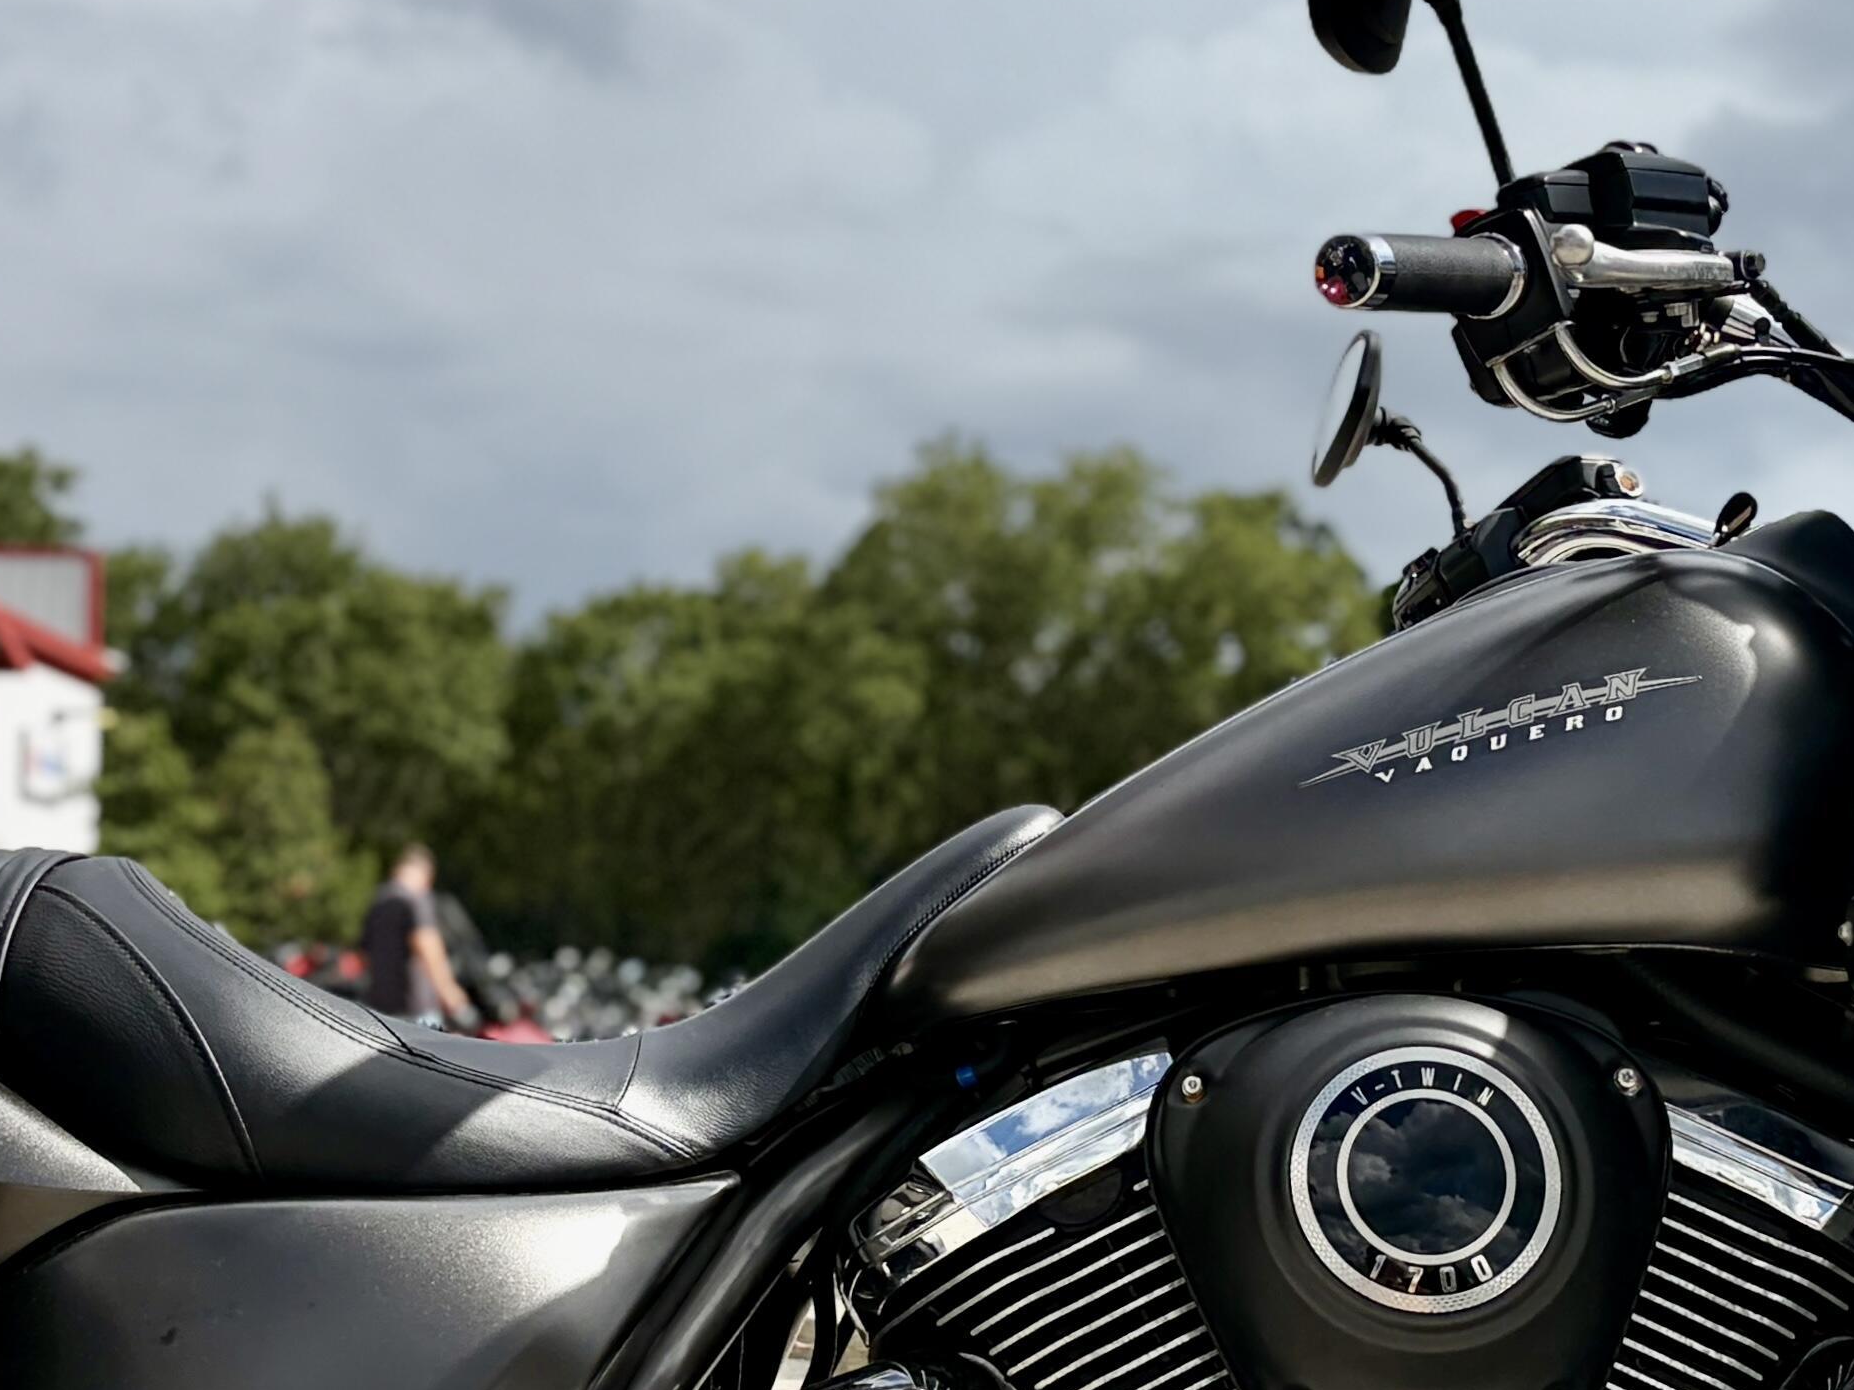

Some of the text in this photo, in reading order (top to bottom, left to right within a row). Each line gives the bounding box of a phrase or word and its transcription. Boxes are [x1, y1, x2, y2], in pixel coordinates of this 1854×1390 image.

[1331, 667, 1649, 774] VULCAN
[1375, 705, 1624, 783] VAQUERO
[1350, 1066, 1496, 1107] V-TWIN
[1369, 1253, 1494, 1293] 1700
